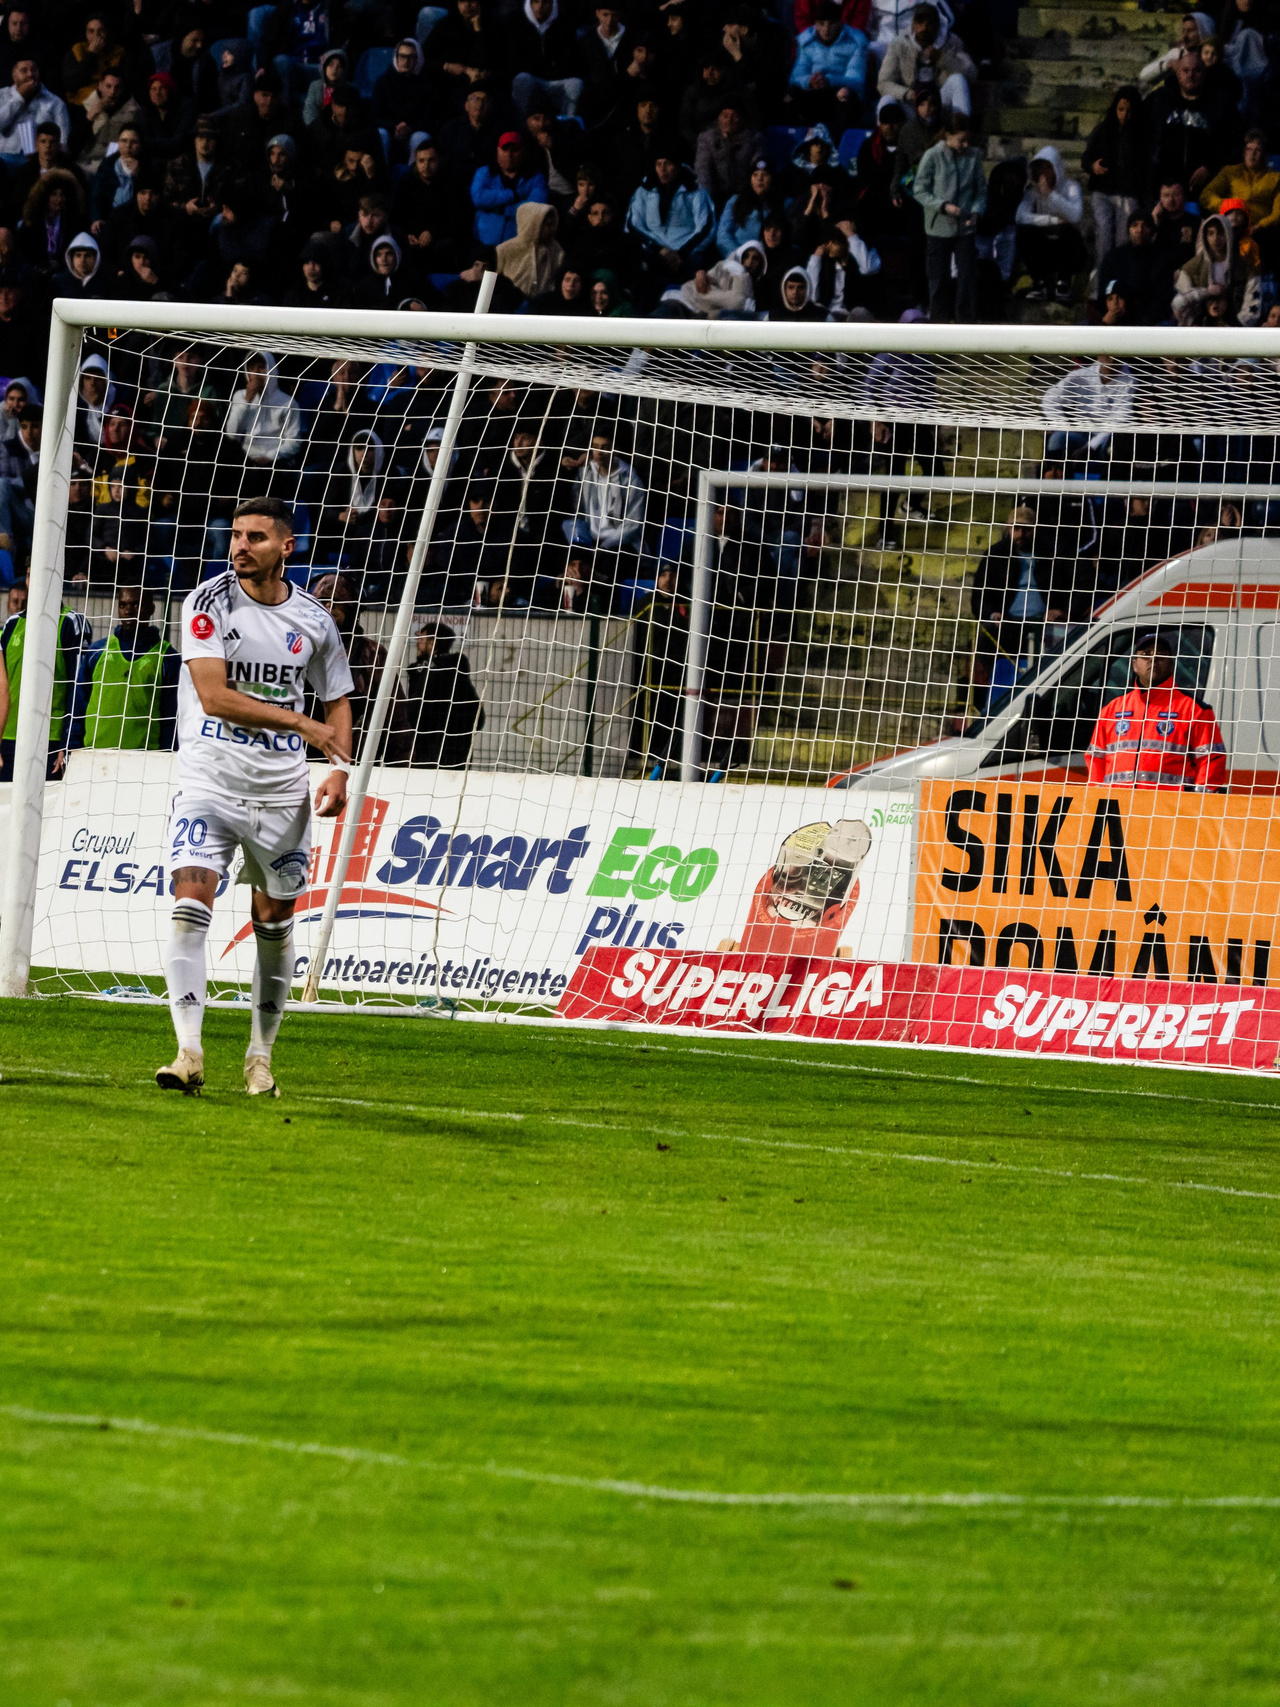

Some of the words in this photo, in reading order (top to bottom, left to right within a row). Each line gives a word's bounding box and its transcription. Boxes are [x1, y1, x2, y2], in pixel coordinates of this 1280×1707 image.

[200, 720, 302, 752] ELSACO
[72, 828, 136, 860] Grupul
[173, 818, 208, 848] 20
[941, 789, 1133, 902] SIKA
[59, 859, 231, 899] ELSA
[376, 815, 591, 894] Smart
[585, 827, 719, 903] Eco
[293, 953, 568, 998] cntoareinteligente
[611, 950, 884, 1019] SUPERLIGA
[982, 984, 1256, 1050] SUPERBET
